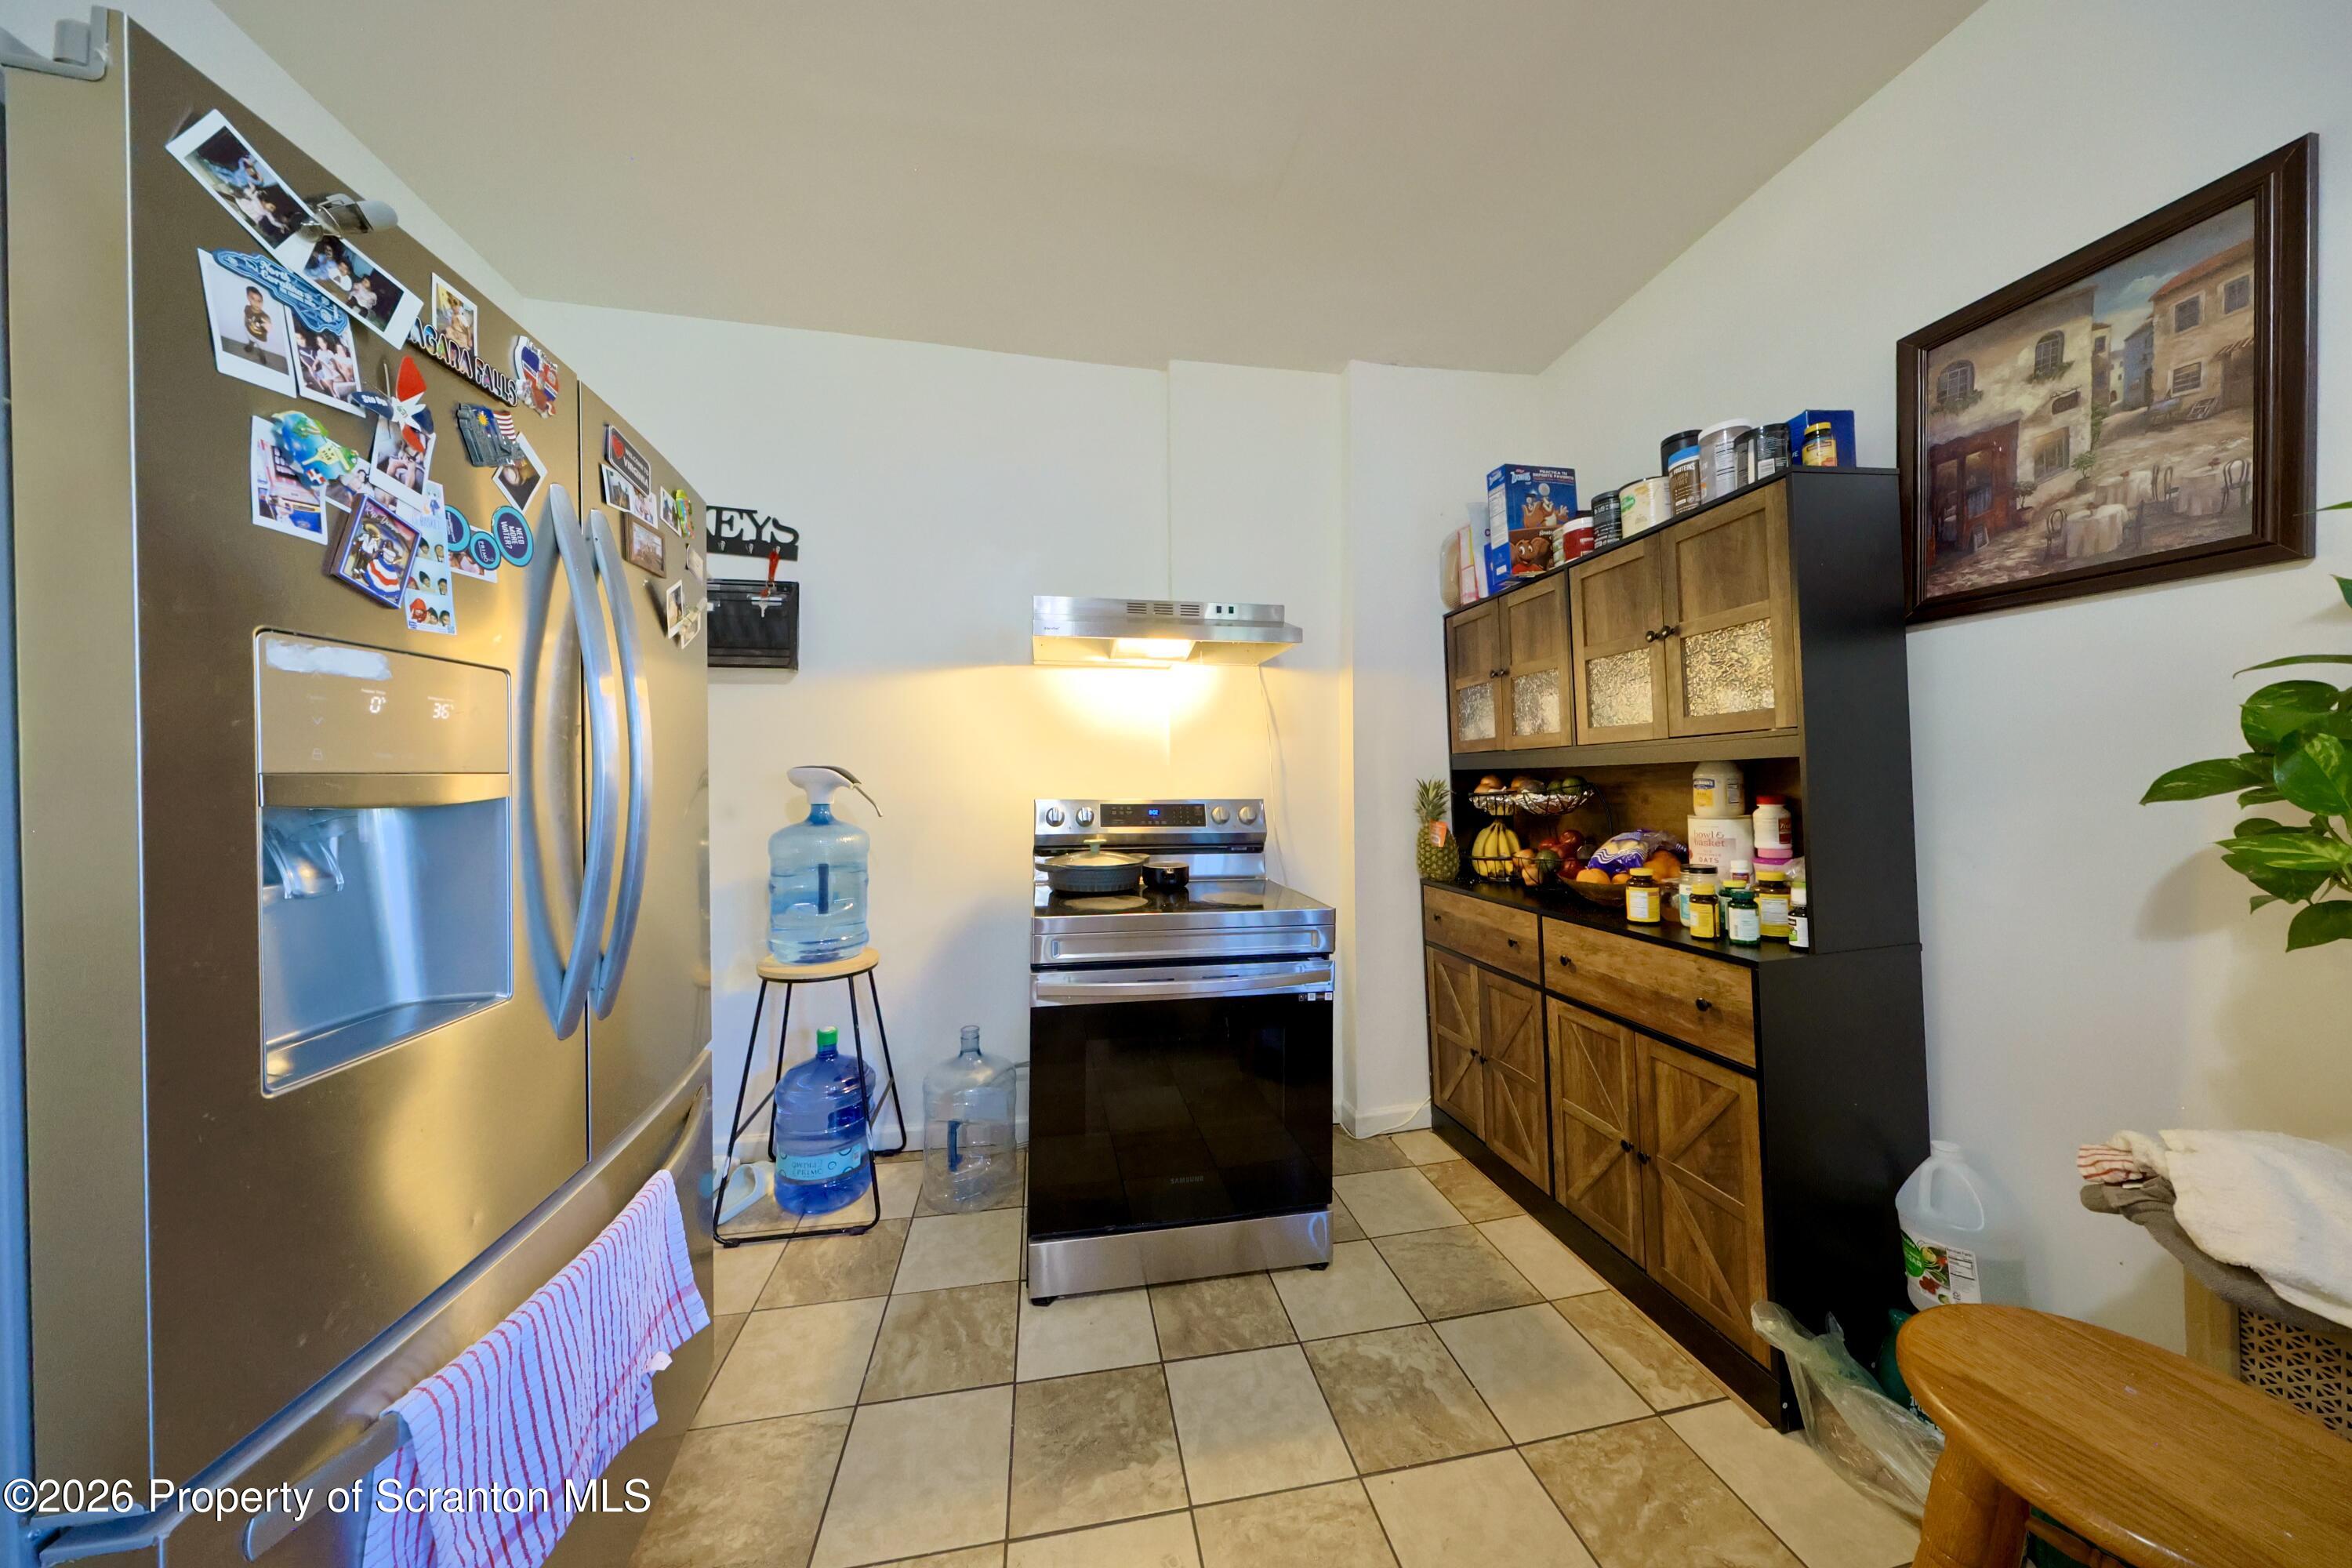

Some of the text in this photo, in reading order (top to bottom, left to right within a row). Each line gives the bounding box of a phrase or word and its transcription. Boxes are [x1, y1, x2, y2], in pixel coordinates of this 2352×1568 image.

[408, 317, 474, 379] AGARA
[474, 357, 518, 408] FALLS
[623, 456, 649, 488] VIRGINIA
[624, 447, 649, 477] WELCOME TO
[1673, 463, 1695, 475] PROTEINS
[500, 521, 513, 550] WATER?
[508, 525, 518, 545] MORE
[515, 527, 525, 545] NEED
[706, 506, 799, 545] EYS
[477, 540, 489, 562] PRIMO
[1693, 829, 1715, 838] bowl
[1693, 837, 1726, 848] basket
[1169, 1175, 1204, 1185] SAMSUNG
